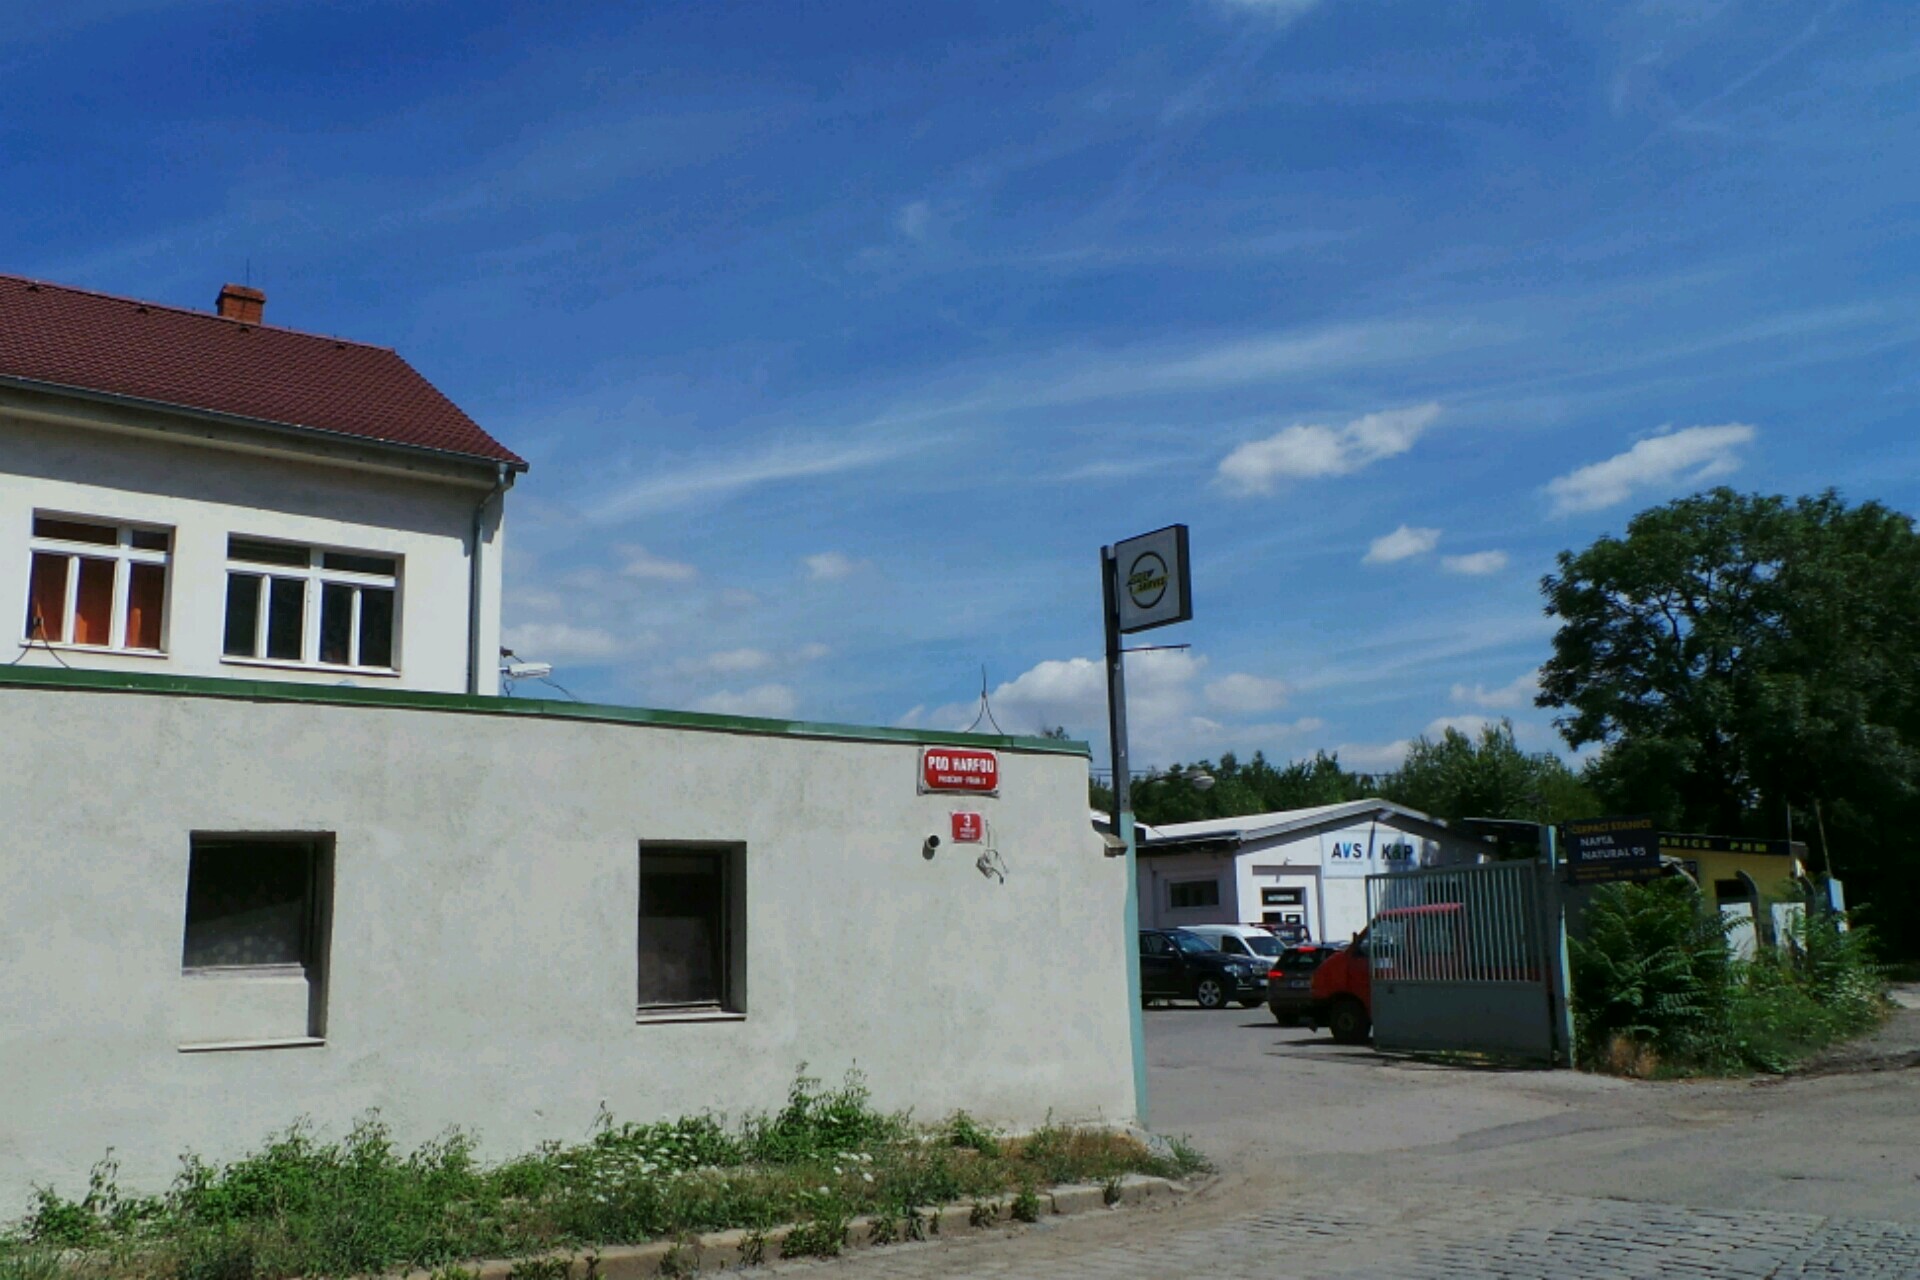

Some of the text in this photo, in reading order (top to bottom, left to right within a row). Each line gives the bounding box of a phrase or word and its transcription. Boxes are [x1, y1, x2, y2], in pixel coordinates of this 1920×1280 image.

[928, 756, 994, 773] POD HARFOU
[963, 815, 971, 826] 3
[1580, 834, 1615, 846] NAFTA
[1331, 842, 1362, 859] AVS
[1582, 846, 1646, 860] NATURAL 95
